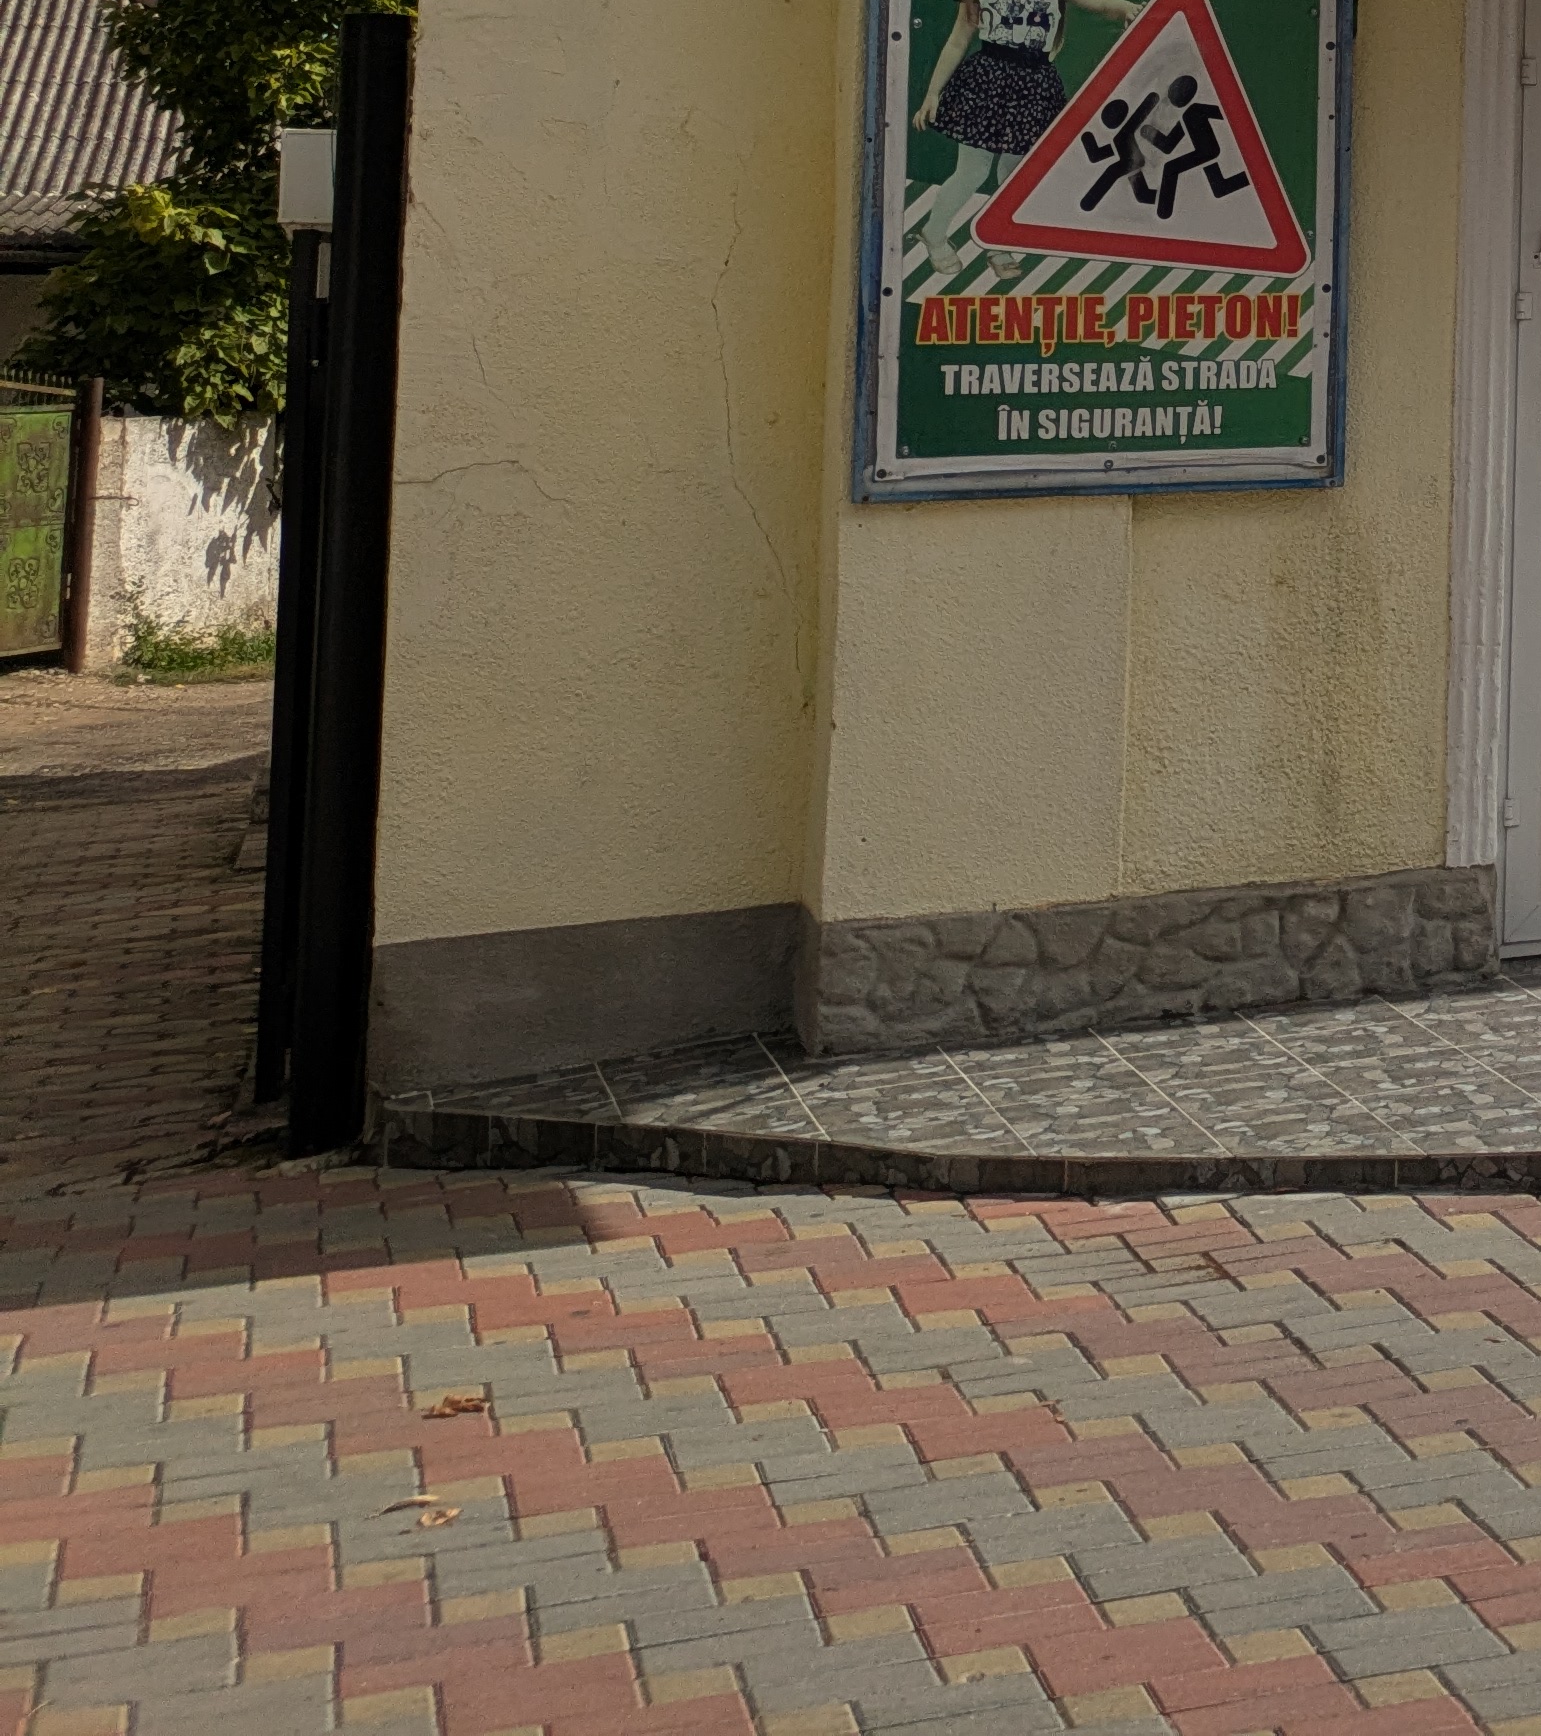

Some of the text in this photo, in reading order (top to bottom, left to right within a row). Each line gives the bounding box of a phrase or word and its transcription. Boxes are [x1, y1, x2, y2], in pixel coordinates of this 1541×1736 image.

[1125, 293, 1302, 343] PIETON!
[940, 355, 1277, 396] TRAVERSEAZĂ STRADA
[997, 404, 1030, 441] ÎN
